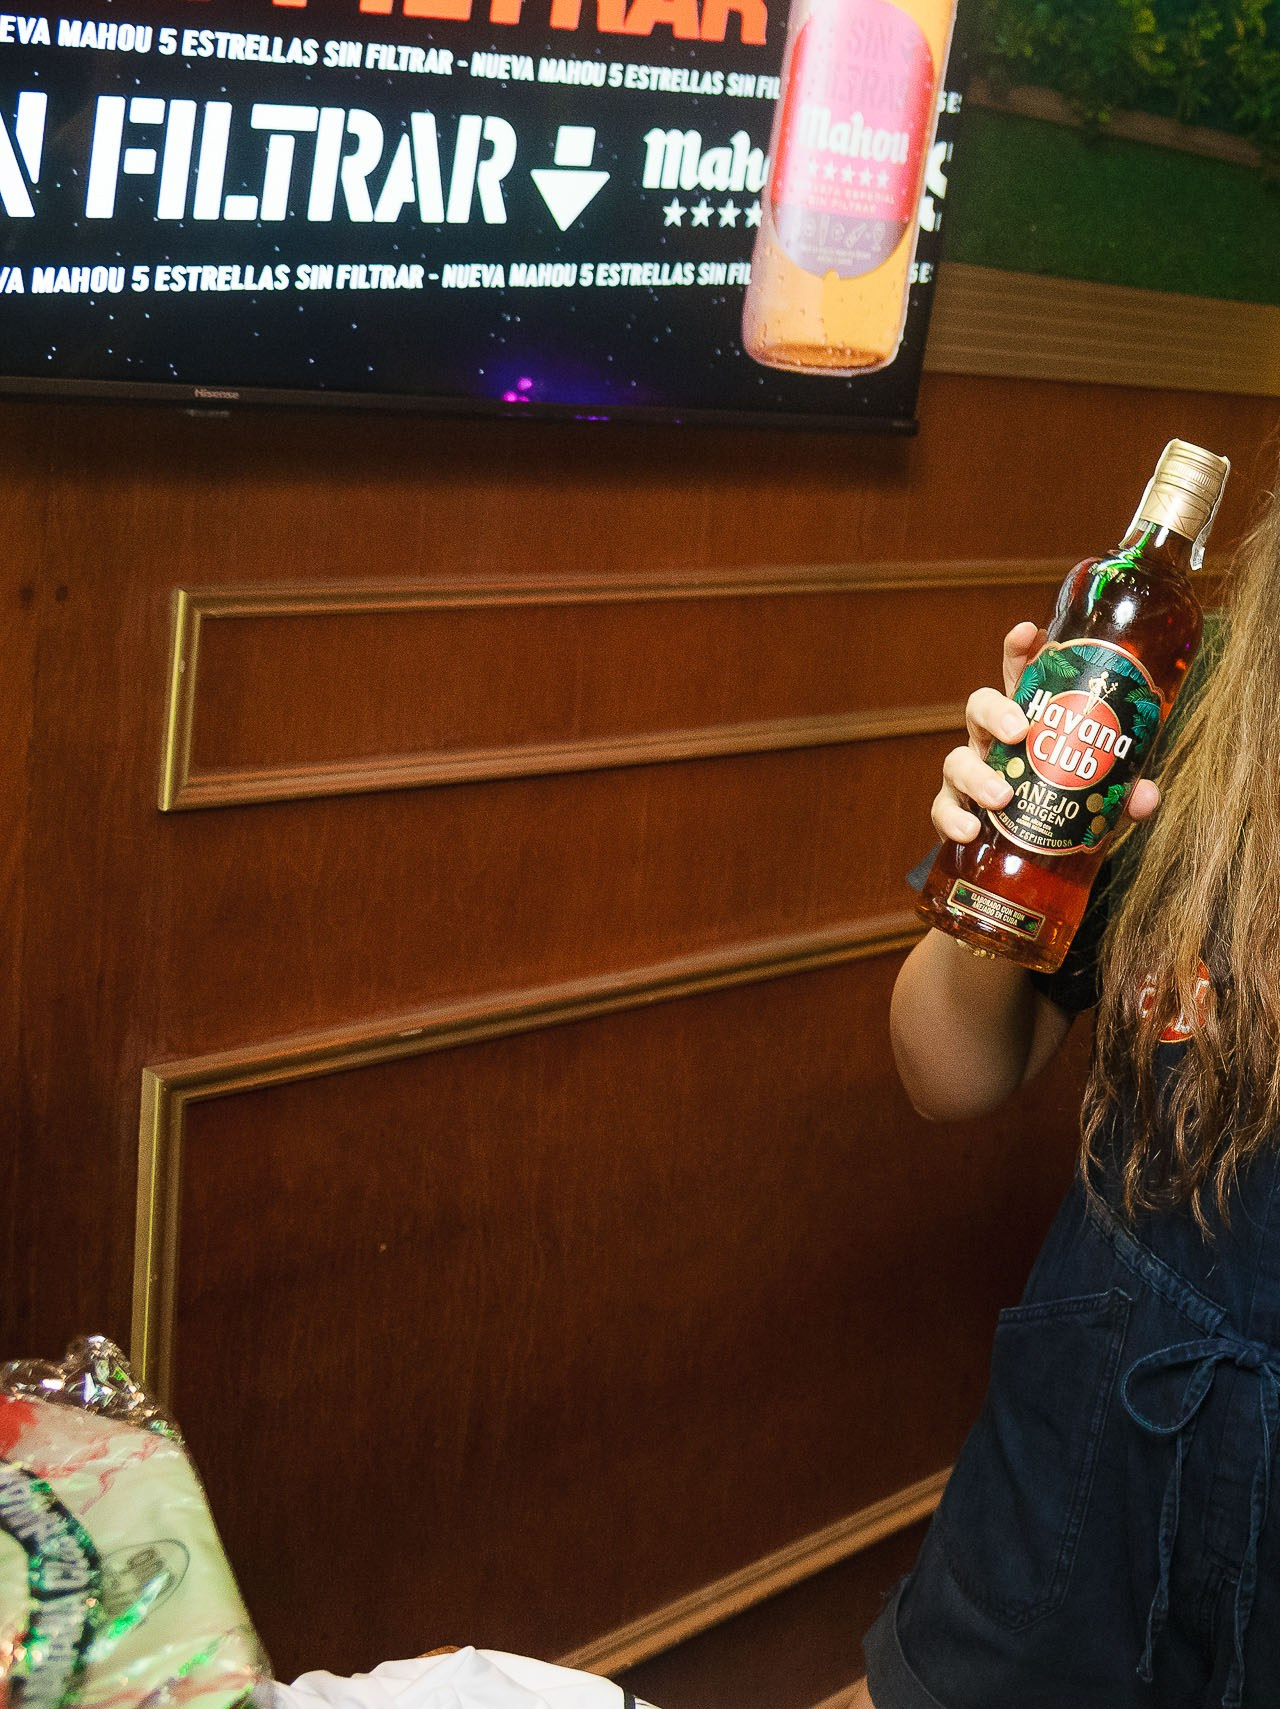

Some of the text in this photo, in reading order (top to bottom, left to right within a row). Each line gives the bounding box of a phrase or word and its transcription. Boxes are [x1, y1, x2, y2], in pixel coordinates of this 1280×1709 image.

[0, 15, 50, 45] EVA
[57, 18, 153, 54] MAHOU
[158, 27, 177, 56] 5
[182, 29, 319, 66] ESTRELLAS
[322, 40, 364, 69] SIN
[365, 42, 454, 76] FILTRAR
[470, 51, 534, 82] NUEVA
[537, 57, 607, 88] MAHOU
[608, 62, 624, 88] 5
[624, 63, 725, 96] ESTRELLAS
[725, 71, 757, 98] SIN
[756, 75, 781, 100] FIL
[798, 103, 910, 165] Mahou
[85, 95, 518, 225] FILTRAR
[642, 127, 771, 193] Mah
[31, 266, 126, 294] MAHOU
[131, 265, 150, 292] 5
[154, 264, 291, 292] ESTRELLAS
[295, 263, 334, 290] SIN
[335, 263, 425, 290] FILTRAR
[441, 263, 505, 289] NUEVA
[508, 262, 578, 288] MAHOU
[579, 263, 595, 287] 5
[595, 262, 696, 287] ESTRELLAS
[697, 262, 727, 286] SIN
[727, 262, 752, 285] FIL
[1025, 688, 1133, 760] Havana
[1032, 729, 1099, 780] Club
[1014, 780, 1080, 820] AÑEJO
[1017, 800, 1066, 827] ORIGEN
[1020, 829, 1073, 848] ESPIRITUOSA
[970, 892, 1001, 911] ELABORADO
